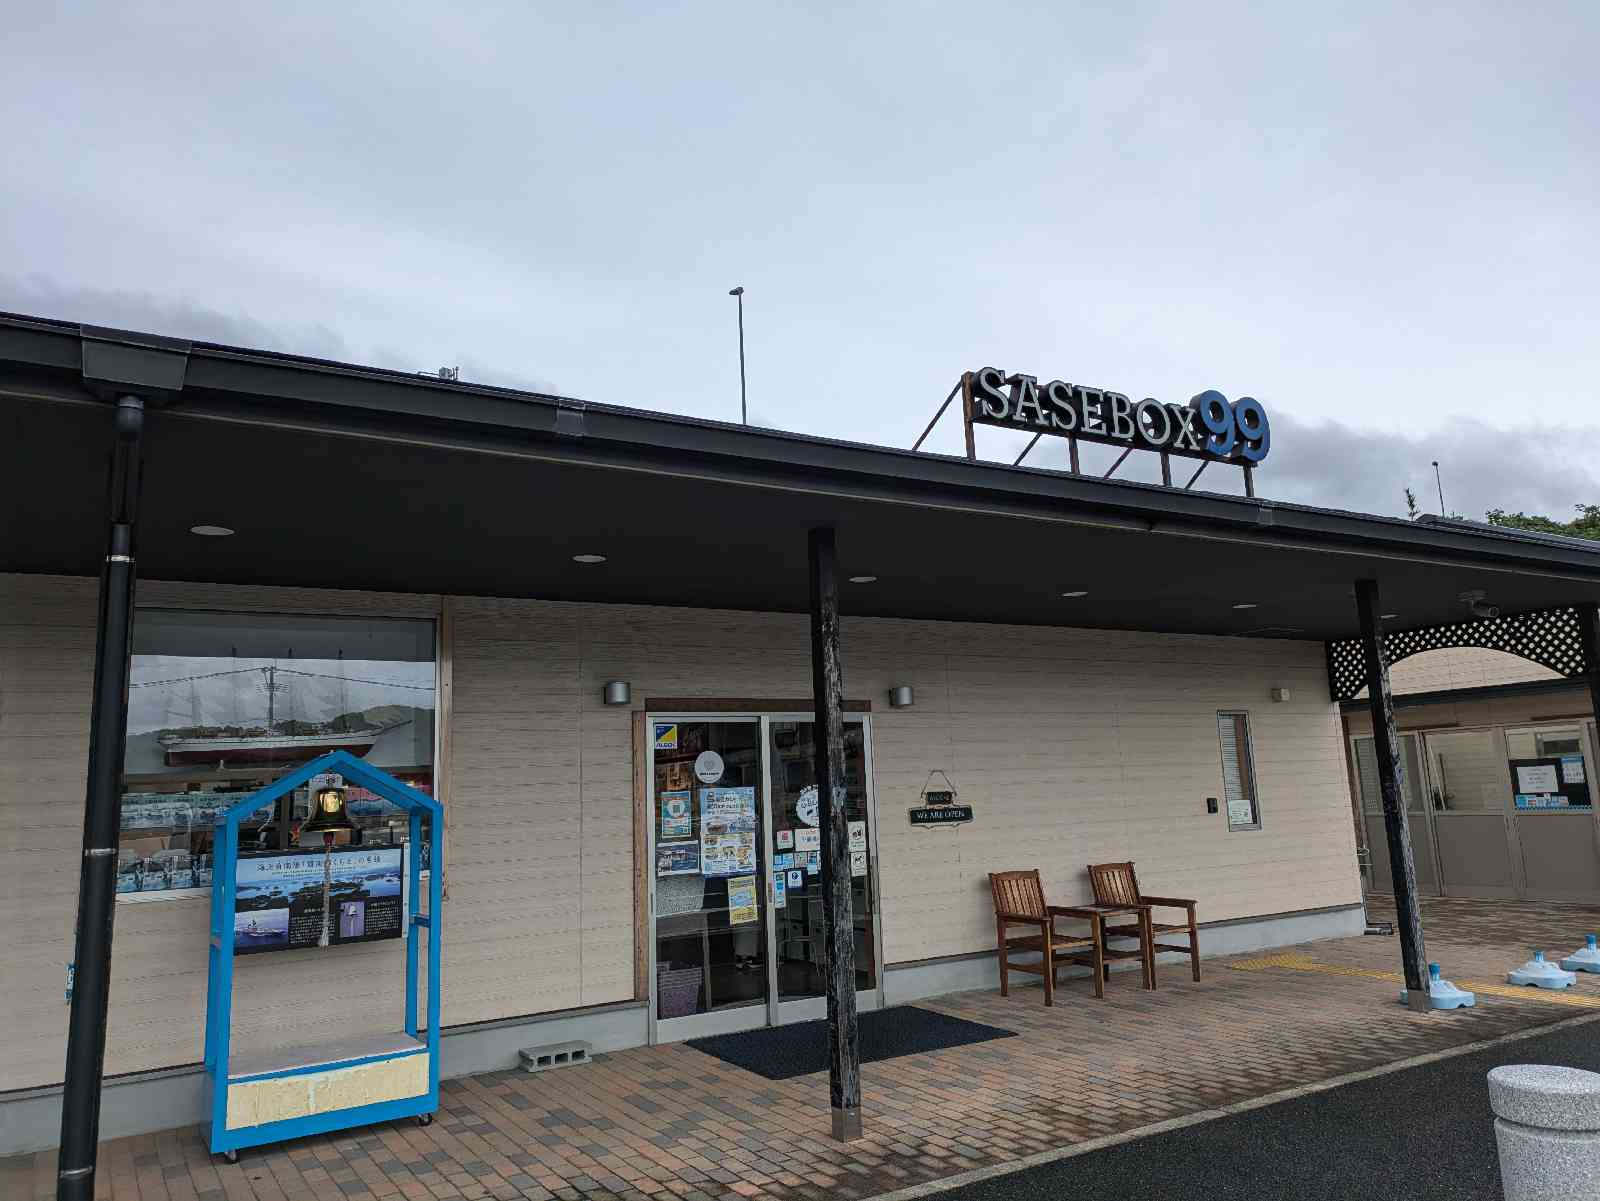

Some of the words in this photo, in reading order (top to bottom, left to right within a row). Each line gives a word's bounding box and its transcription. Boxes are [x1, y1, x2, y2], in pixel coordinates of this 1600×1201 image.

[917, 810, 928, 819] WE
[929, 810, 943, 819] ARE
[944, 809, 966, 818] OPEN
